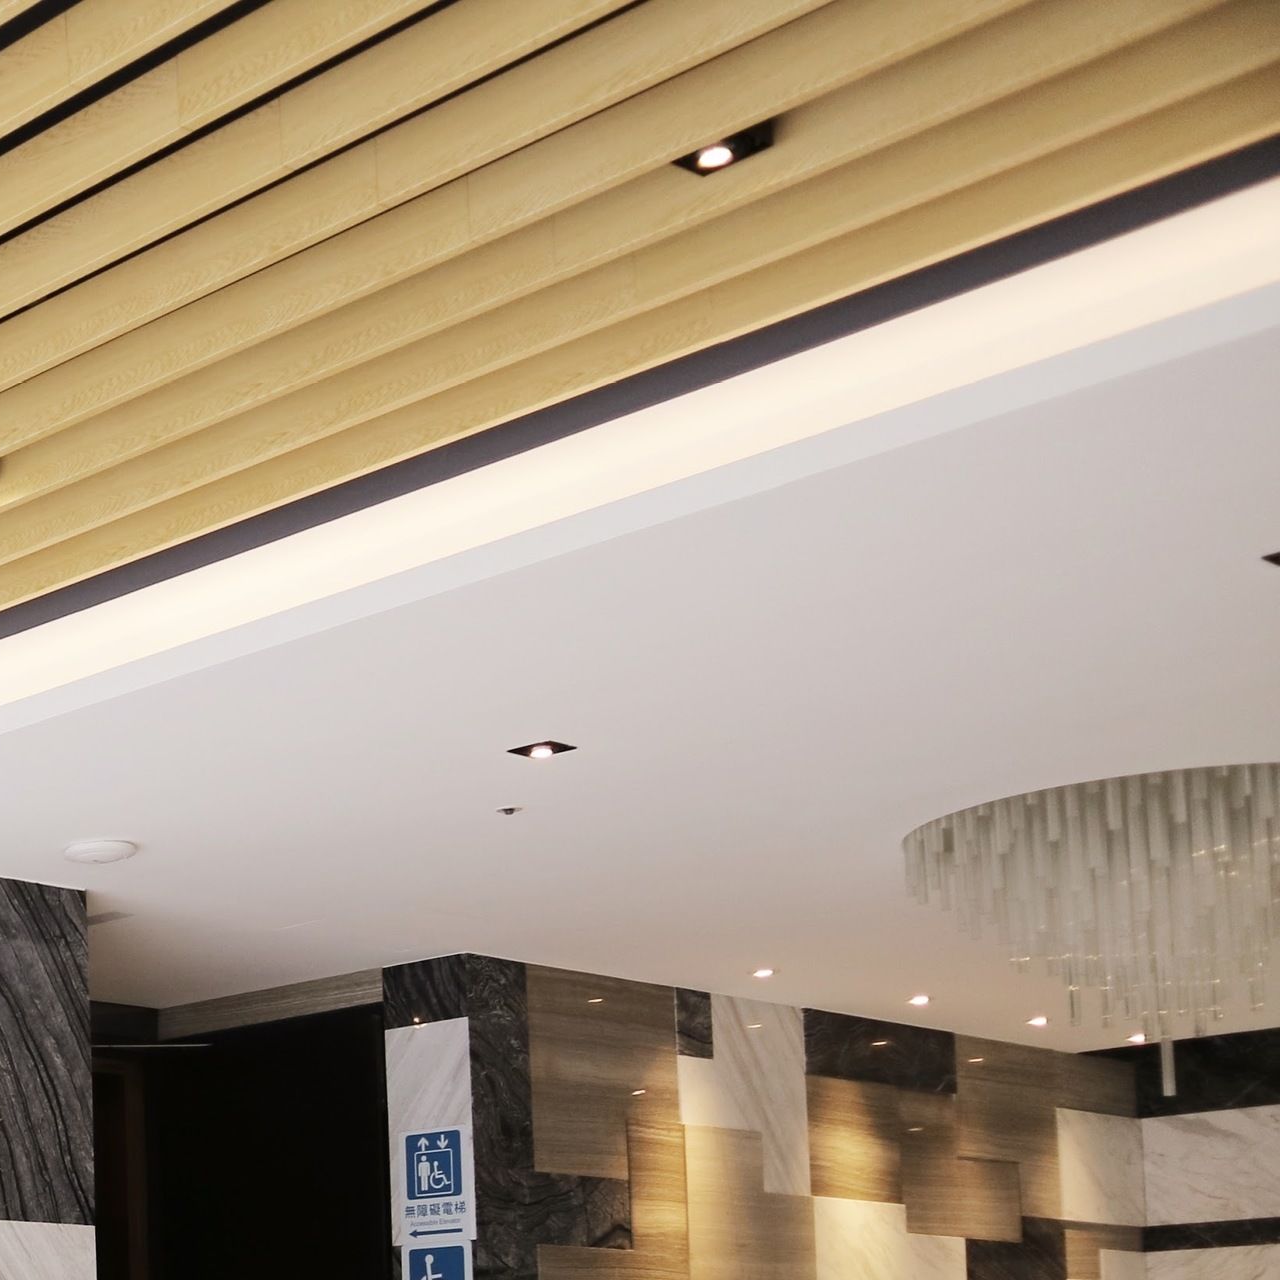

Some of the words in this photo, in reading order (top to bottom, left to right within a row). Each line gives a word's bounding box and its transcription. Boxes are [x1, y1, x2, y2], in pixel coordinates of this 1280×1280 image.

[405, 1201, 466, 1218] 無障礙電梯
